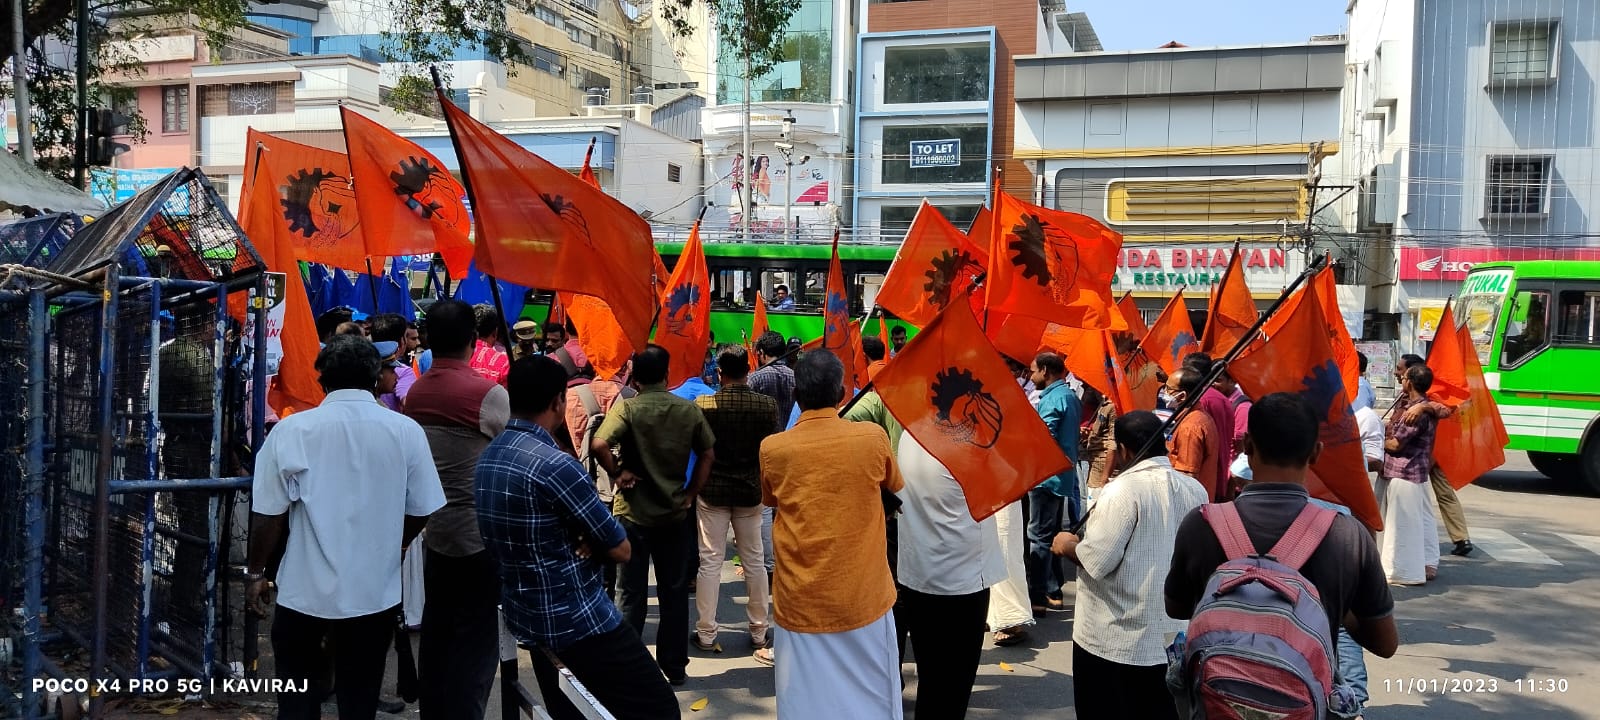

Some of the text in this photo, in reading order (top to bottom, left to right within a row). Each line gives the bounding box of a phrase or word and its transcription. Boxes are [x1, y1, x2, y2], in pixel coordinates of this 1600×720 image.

[917, 143, 953, 154] TO LET
[1441, 261, 1476, 272] HO
[1133, 272, 1220, 285] RESTAURA
